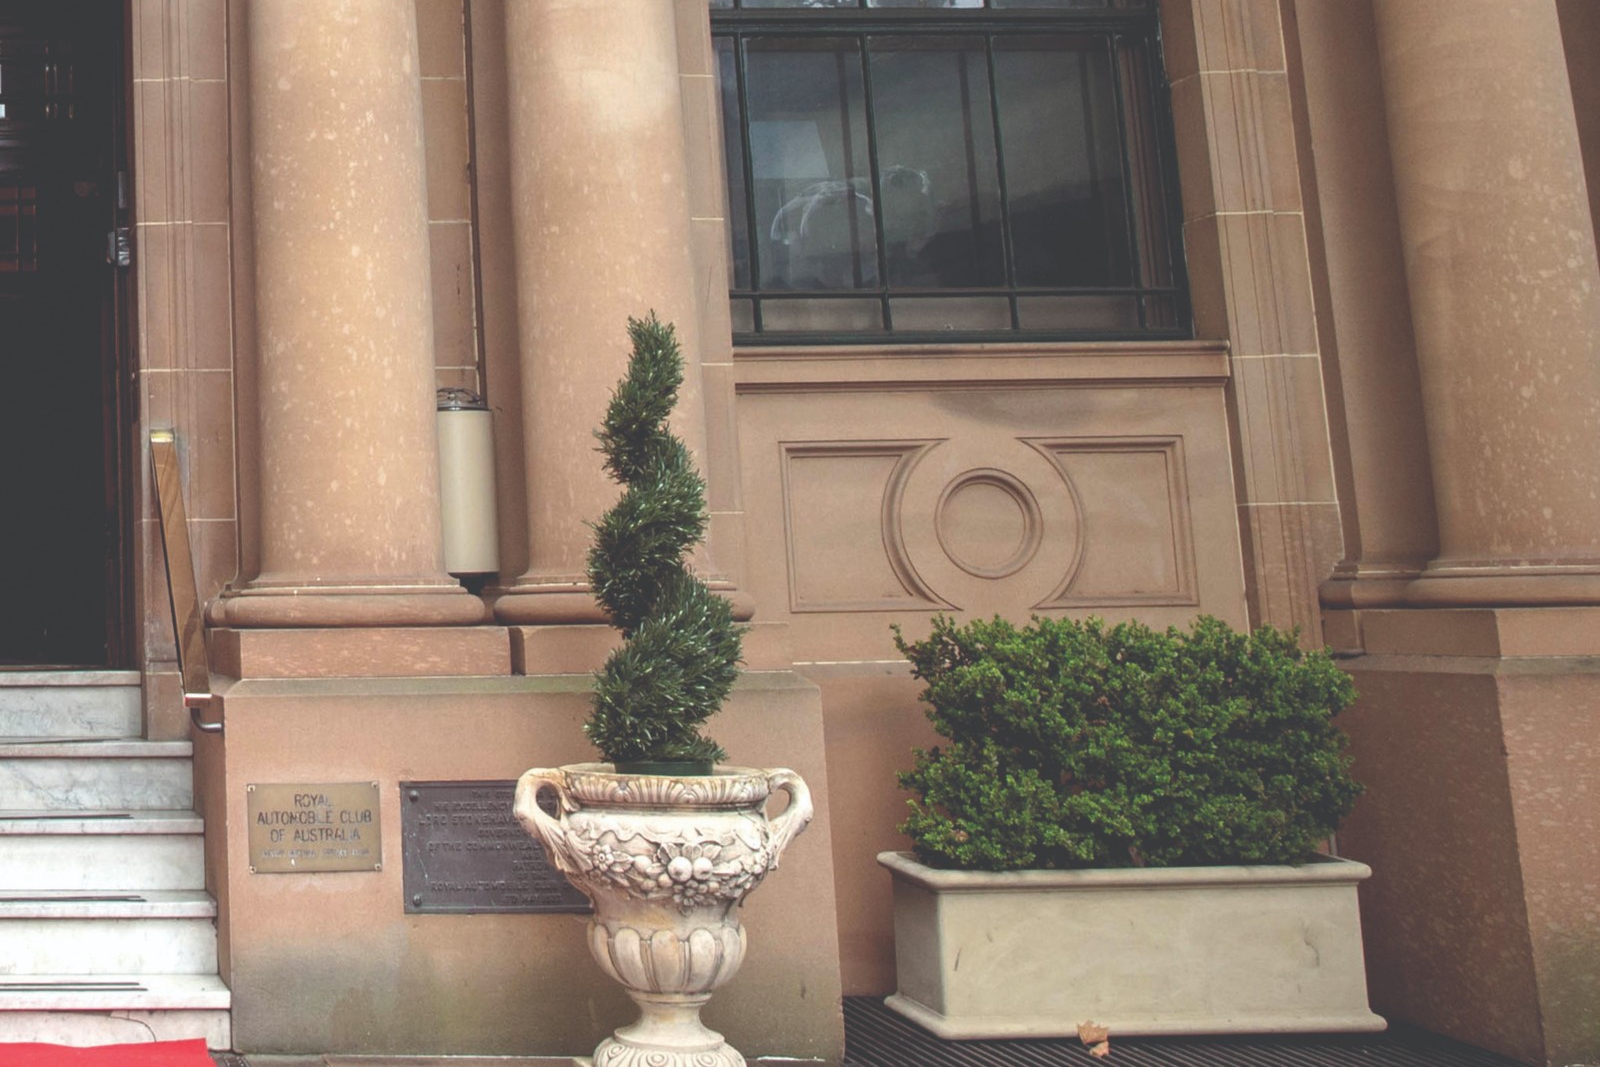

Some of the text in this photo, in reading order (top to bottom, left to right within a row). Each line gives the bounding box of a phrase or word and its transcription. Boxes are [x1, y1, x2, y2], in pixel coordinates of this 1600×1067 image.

[294, 793, 334, 808] ROYAL
[340, 809, 372, 824] CLUB
[270, 828, 361, 843] OF AUSTRALIA
